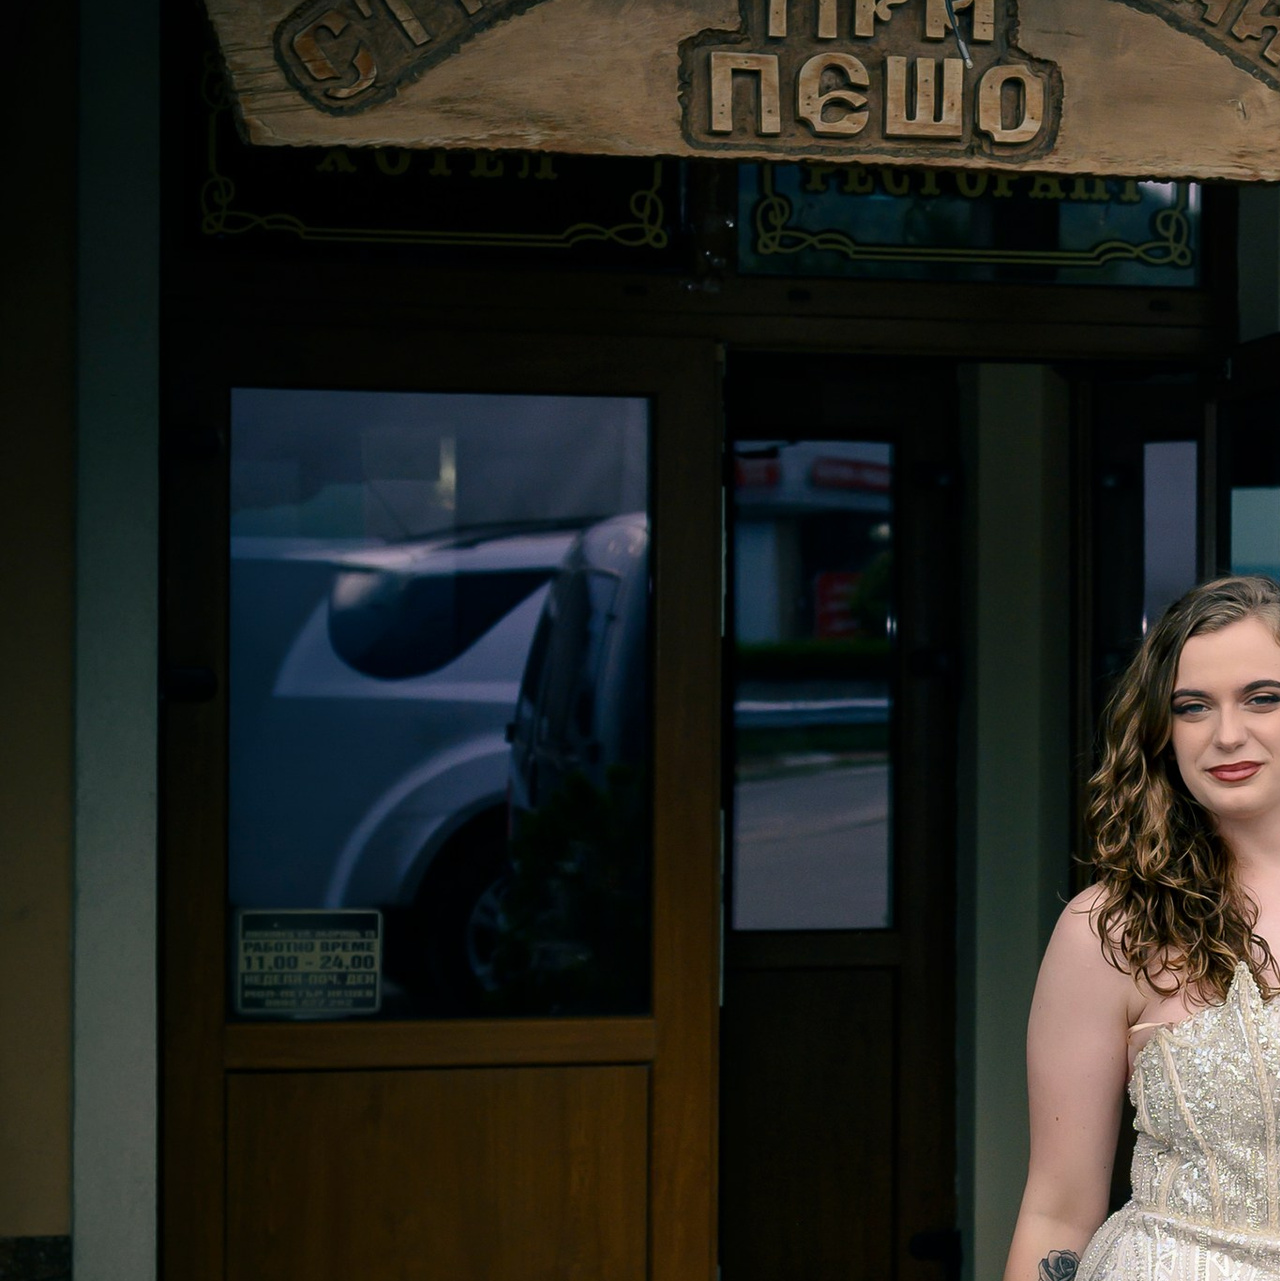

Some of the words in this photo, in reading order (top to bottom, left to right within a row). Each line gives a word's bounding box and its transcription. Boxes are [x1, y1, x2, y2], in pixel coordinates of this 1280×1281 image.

[243, 942, 315, 953] РАБОТНО
[320, 941, 375, 953] ВРЕМЕ
[245, 955, 299, 970] 11.00
[319, 955, 375, 970] 24.00
[346, 974, 375, 986] ДЕН
